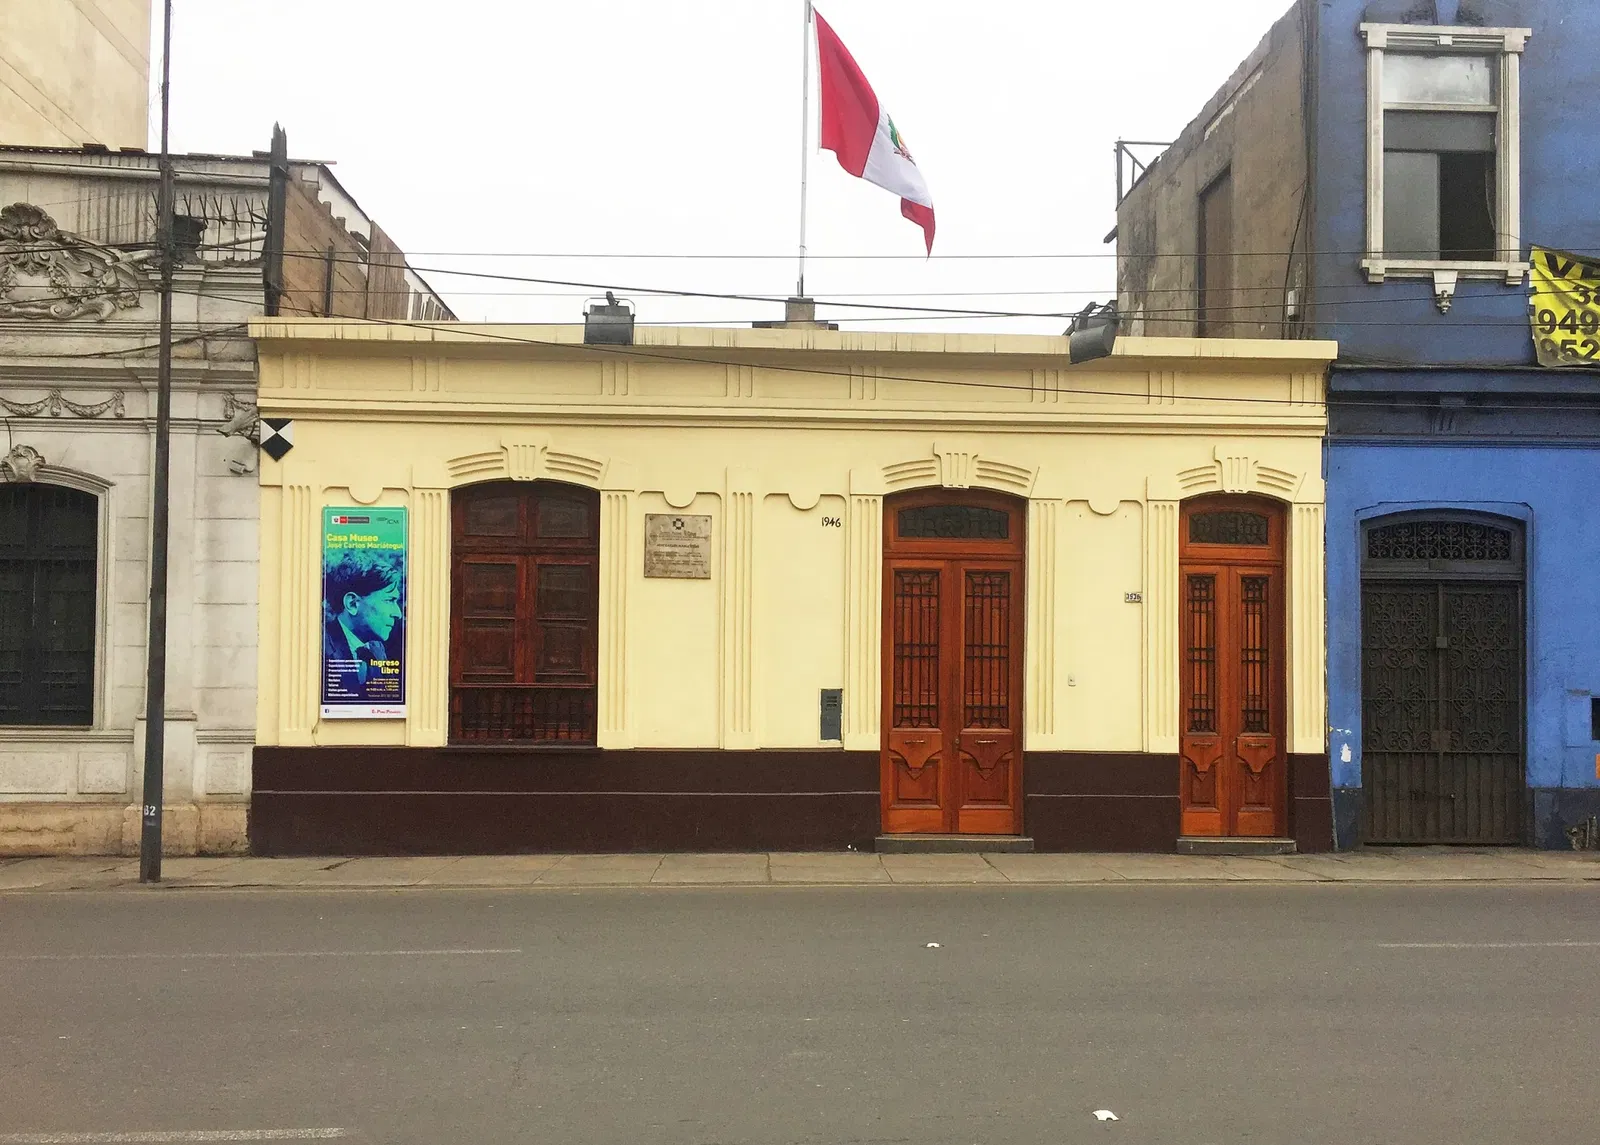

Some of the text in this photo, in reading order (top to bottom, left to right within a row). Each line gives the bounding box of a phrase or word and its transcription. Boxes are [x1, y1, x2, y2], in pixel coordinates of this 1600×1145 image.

[1538, 309, 1599, 335] 949
[821, 516, 842, 528] 1946
[327, 534, 379, 542] Casa Museo
[370, 659, 400, 667] Ingreso
